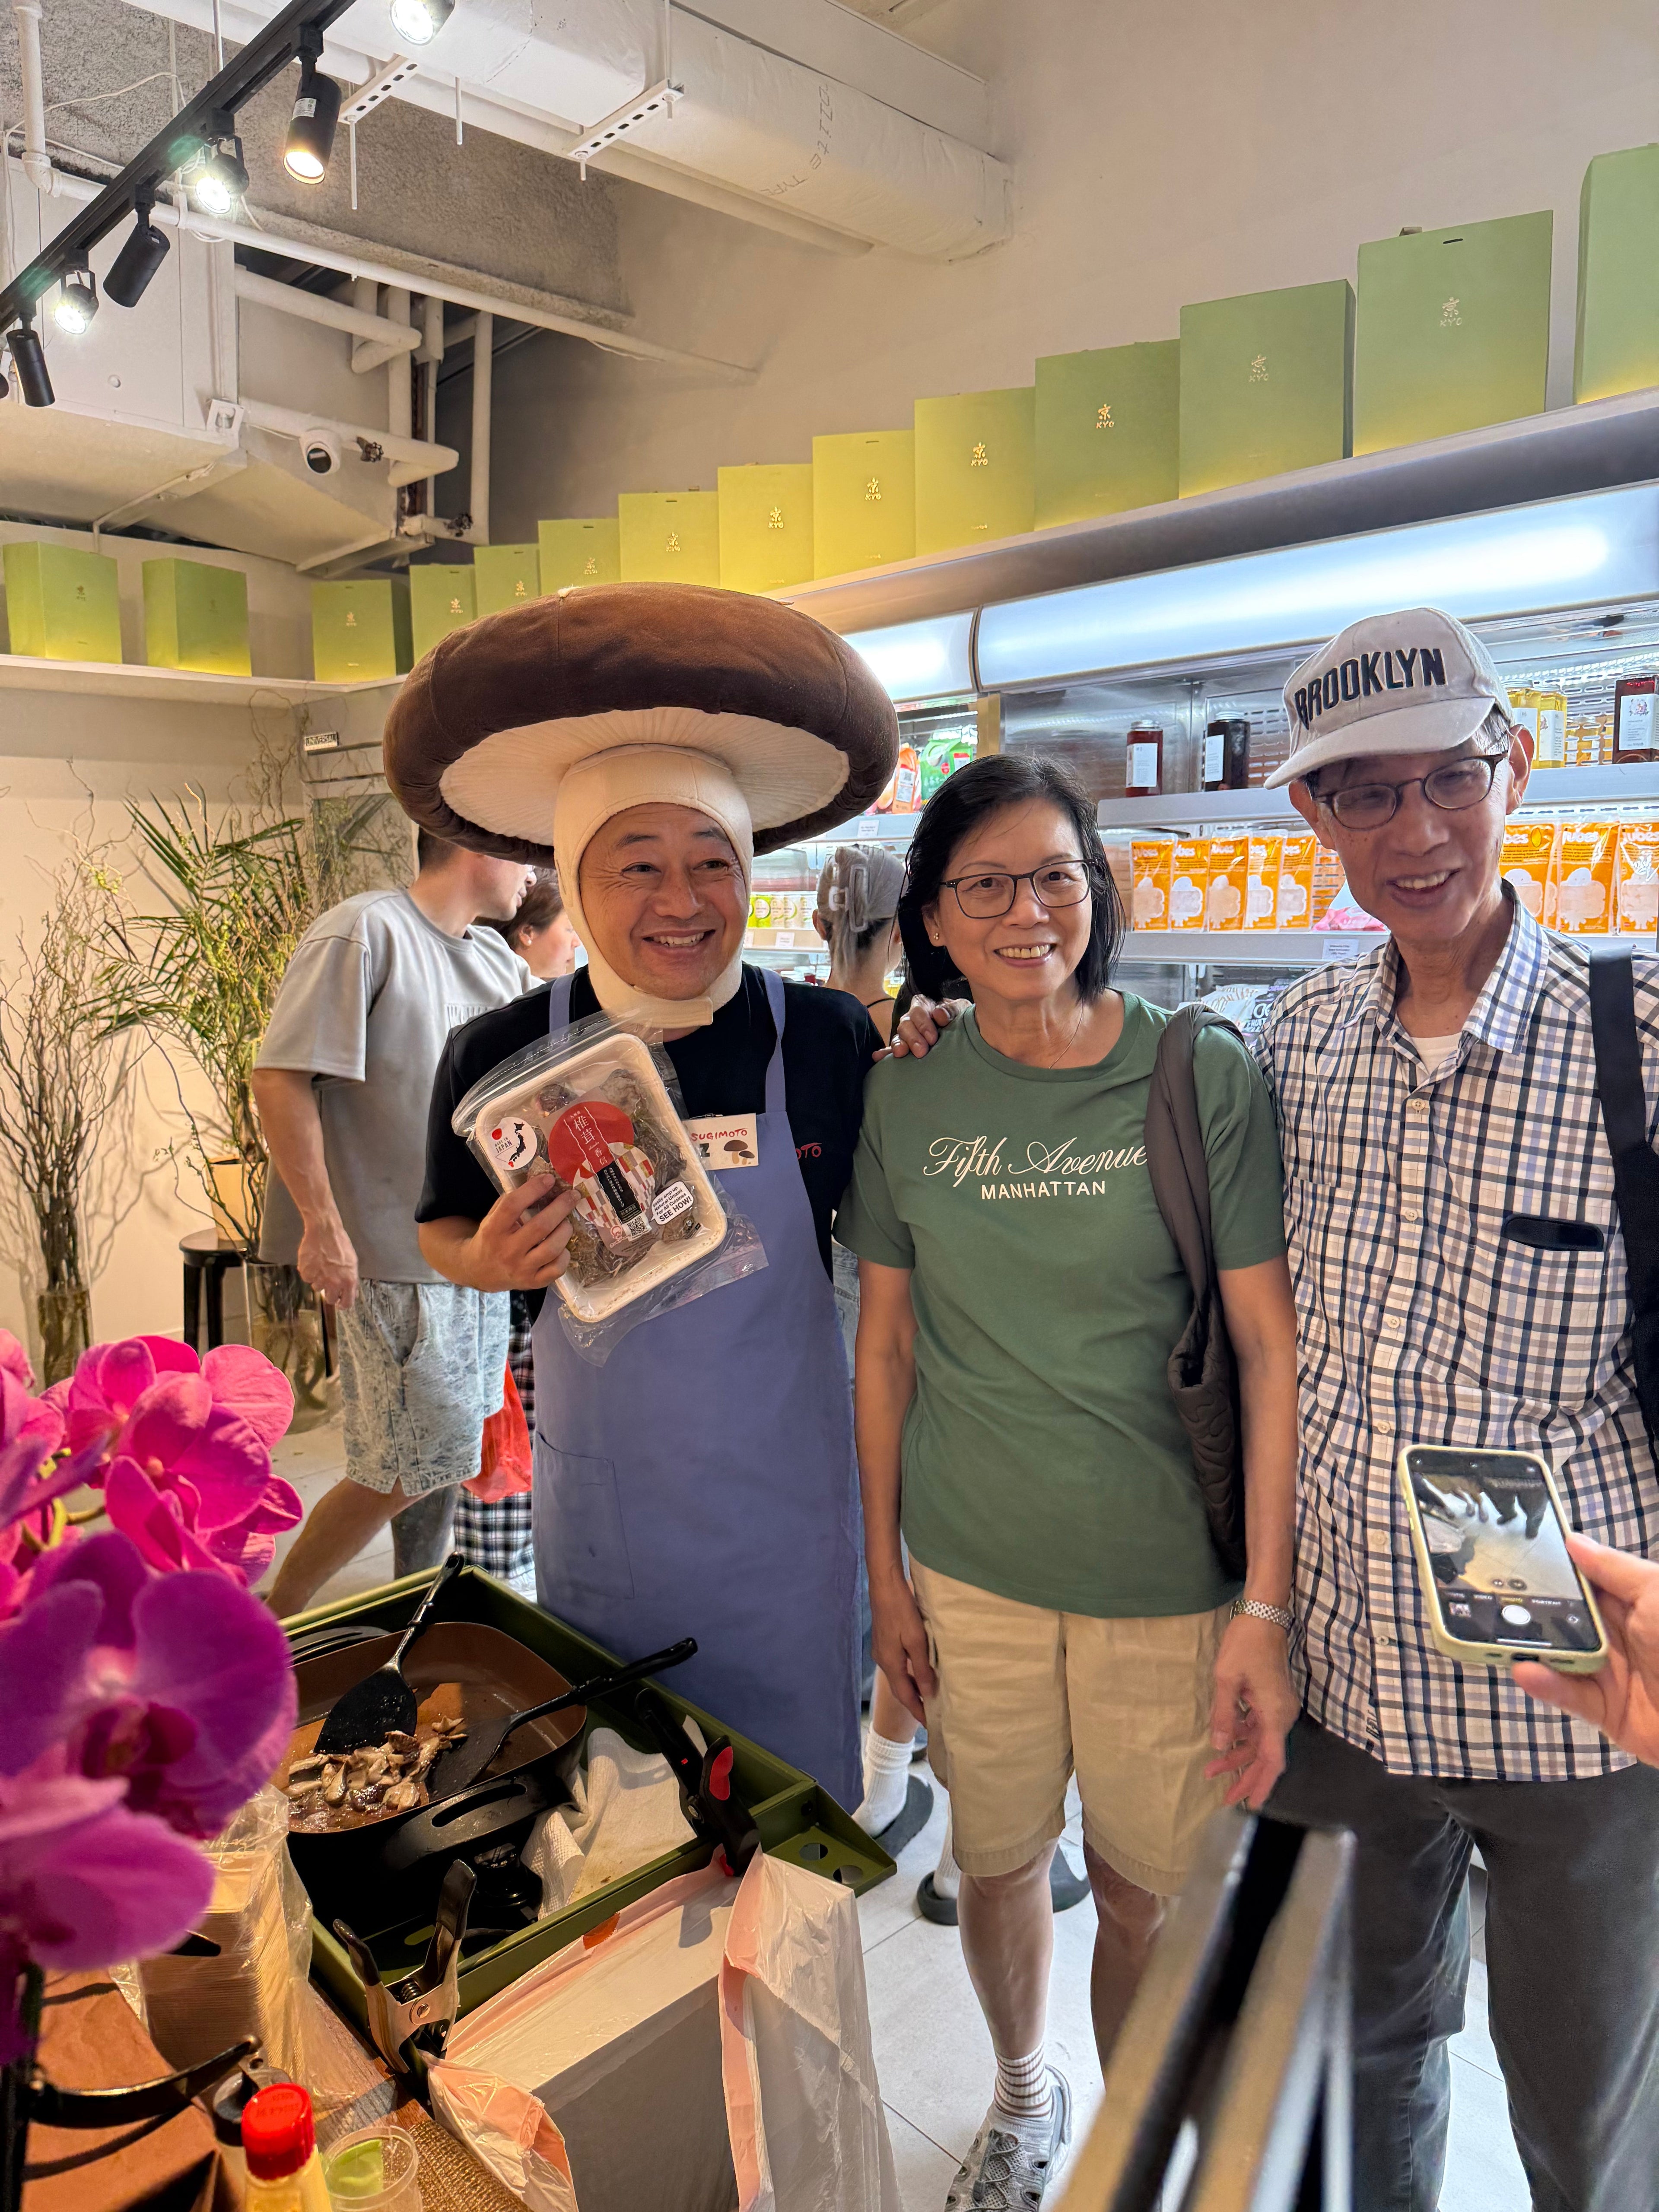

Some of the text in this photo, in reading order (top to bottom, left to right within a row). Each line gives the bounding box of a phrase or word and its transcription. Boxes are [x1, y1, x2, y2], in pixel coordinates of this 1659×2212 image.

[1440, 318, 1462, 326] KYO
[1098, 404, 1111, 420] 京
[1294, 648, 1447, 731] BROOKLYN
[574, 1116, 595, 1144] 椎茸
[691, 1128, 748, 1141] SUGIMOTO
[496, 1140, 512, 1153] JAPAN
[923, 1135, 1148, 1187] Fifth Avenue
[982, 1180, 1105, 1199] MANHATTAN
[653, 1197, 663, 1208] Easily
[664, 1190, 672, 1198] amp
[655, 1189, 683, 1212] Natural Umami
[670, 1193, 687, 1206] Cuisines
[659, 1196, 692, 1221] SEE HOW!
